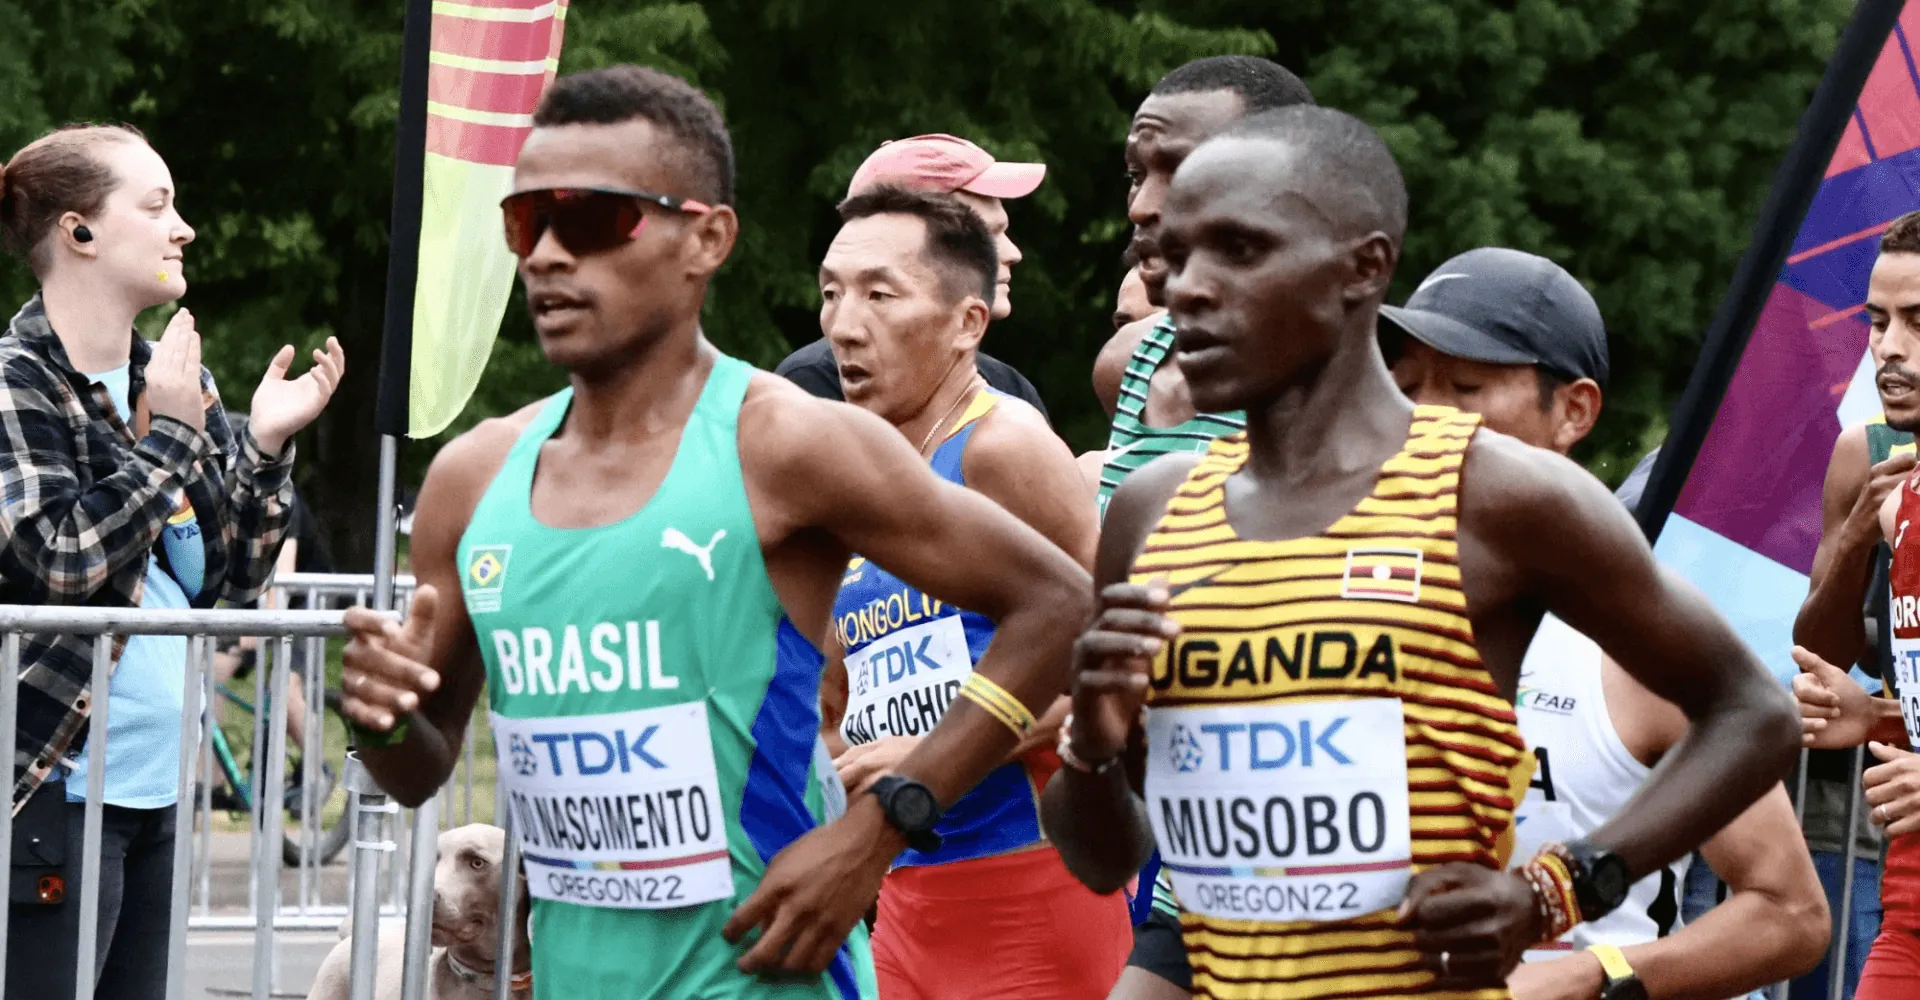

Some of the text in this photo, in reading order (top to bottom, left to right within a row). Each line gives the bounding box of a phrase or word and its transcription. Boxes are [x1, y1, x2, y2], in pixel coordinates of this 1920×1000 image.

[835, 588, 942, 649] MONGOLI
[491, 620, 679, 696] BRASIL
[869, 635, 942, 688] TDK
[1150, 631, 1397, 690] UGANDA
[1534, 692, 1576, 710] FAB
[532, 725, 668, 776] TDK
[1200, 716, 1355, 771] TDK
[533, 785, 711, 851] NASCIMENTO
[1160, 791, 1386, 858] MUSOBO
[547, 874, 685, 902] OREGON22
[1200, 882, 1361, 913] OREGON22
